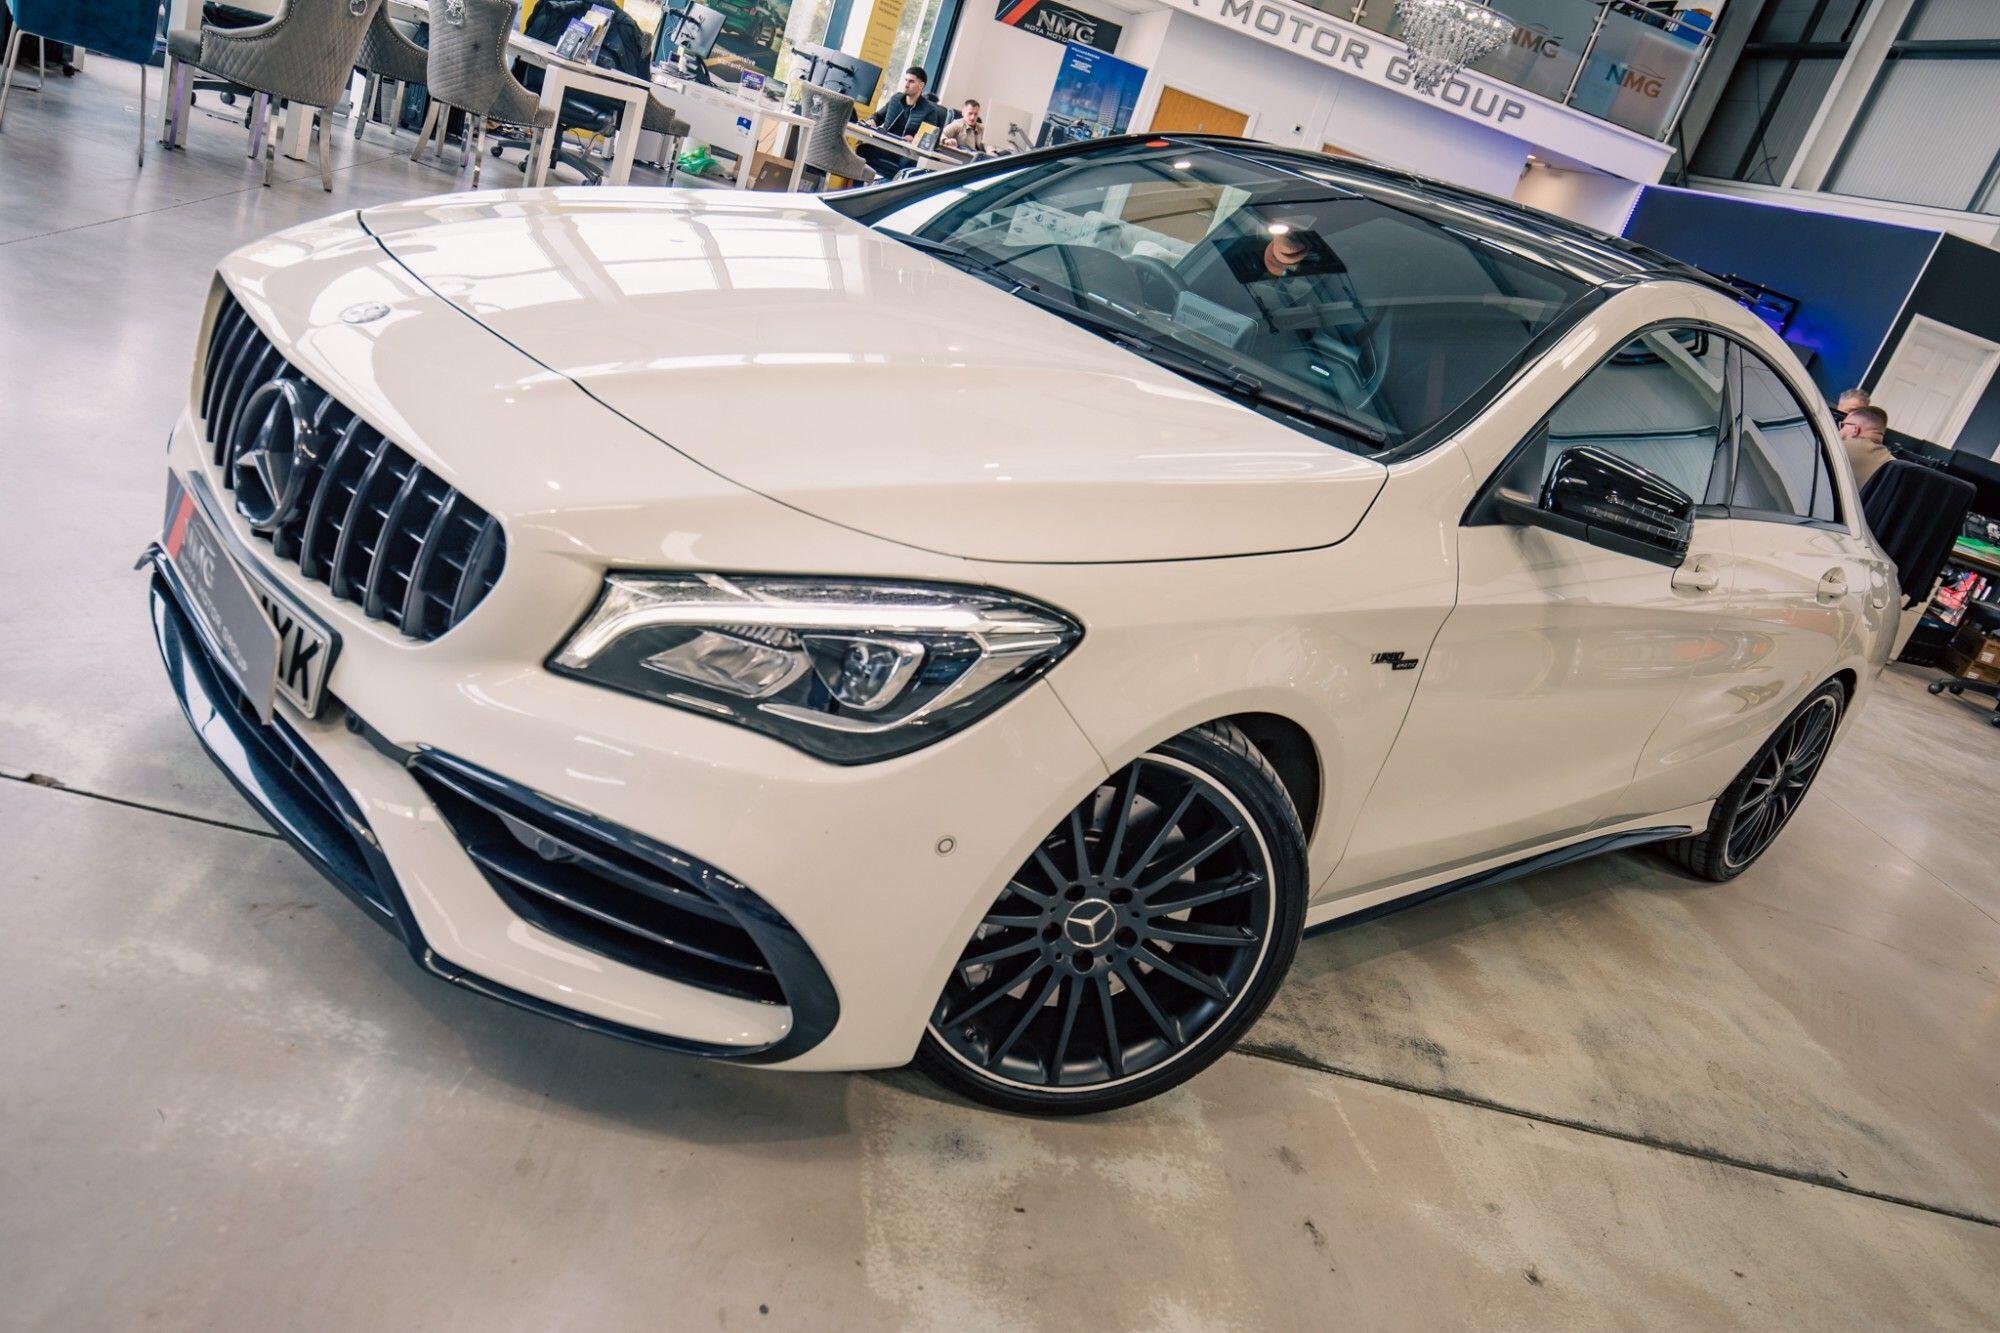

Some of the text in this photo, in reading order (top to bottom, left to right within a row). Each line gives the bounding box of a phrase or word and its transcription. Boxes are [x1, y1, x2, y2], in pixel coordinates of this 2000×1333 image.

[1023, 22, 1069, 44] NOYA MOTO
[1036, 9, 1096, 45] NMG
[1220, 0, 1369, 69] MOTOR
[1604, 63, 1663, 98] NMG
